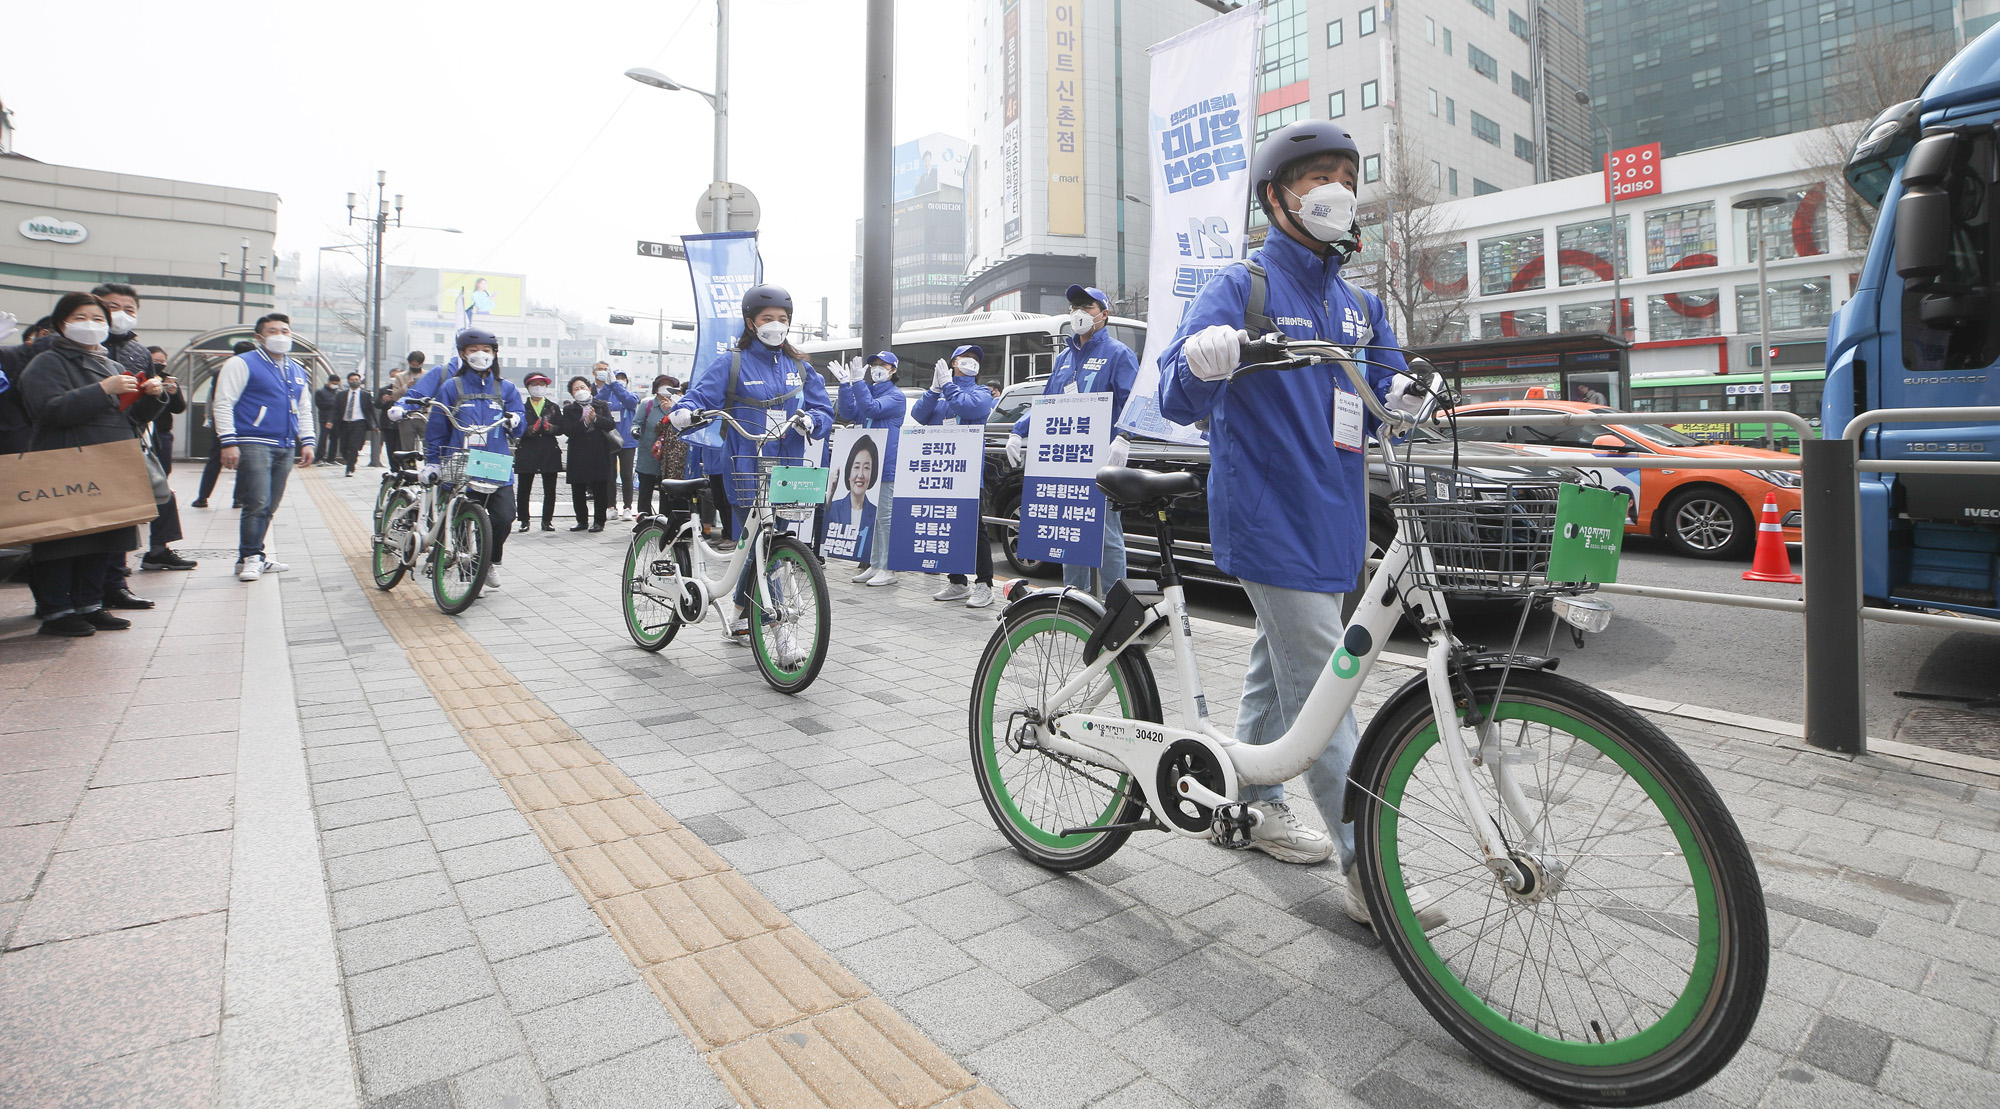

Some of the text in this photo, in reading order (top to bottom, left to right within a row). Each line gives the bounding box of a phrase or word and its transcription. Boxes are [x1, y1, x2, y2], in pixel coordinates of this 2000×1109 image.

[1055, 5, 1077, 153] 이마트 신촌점
[1052, 173, 1079, 184] emart
[1613, 179, 1654, 196] daiso
[1903, 375, 1987, 385] EUROCARGO
[921, 442, 956, 456] 공직자
[1038, 443, 1094, 463] 균형발전
[1906, 442, 1986, 452] 180-320
[908, 459, 967, 473] 부동산거래
[918, 476, 954, 490] 신고제
[17, 481, 101, 502] CALMA
[1036, 483, 1090, 500] 강북횡단선
[910, 504, 958, 519] 투기근절
[1028, 503, 1097, 522] 경전철 서부선
[1964, 507, 2000, 518] IVEC
[826, 521, 860, 540] 합니다
[914, 522, 952, 537] 부동산
[1037, 524, 1081, 543] 조기착공
[823, 538, 858, 557] 박영선
[913, 539, 950, 555] 감독청
[1135, 728, 1164, 743] 30420
